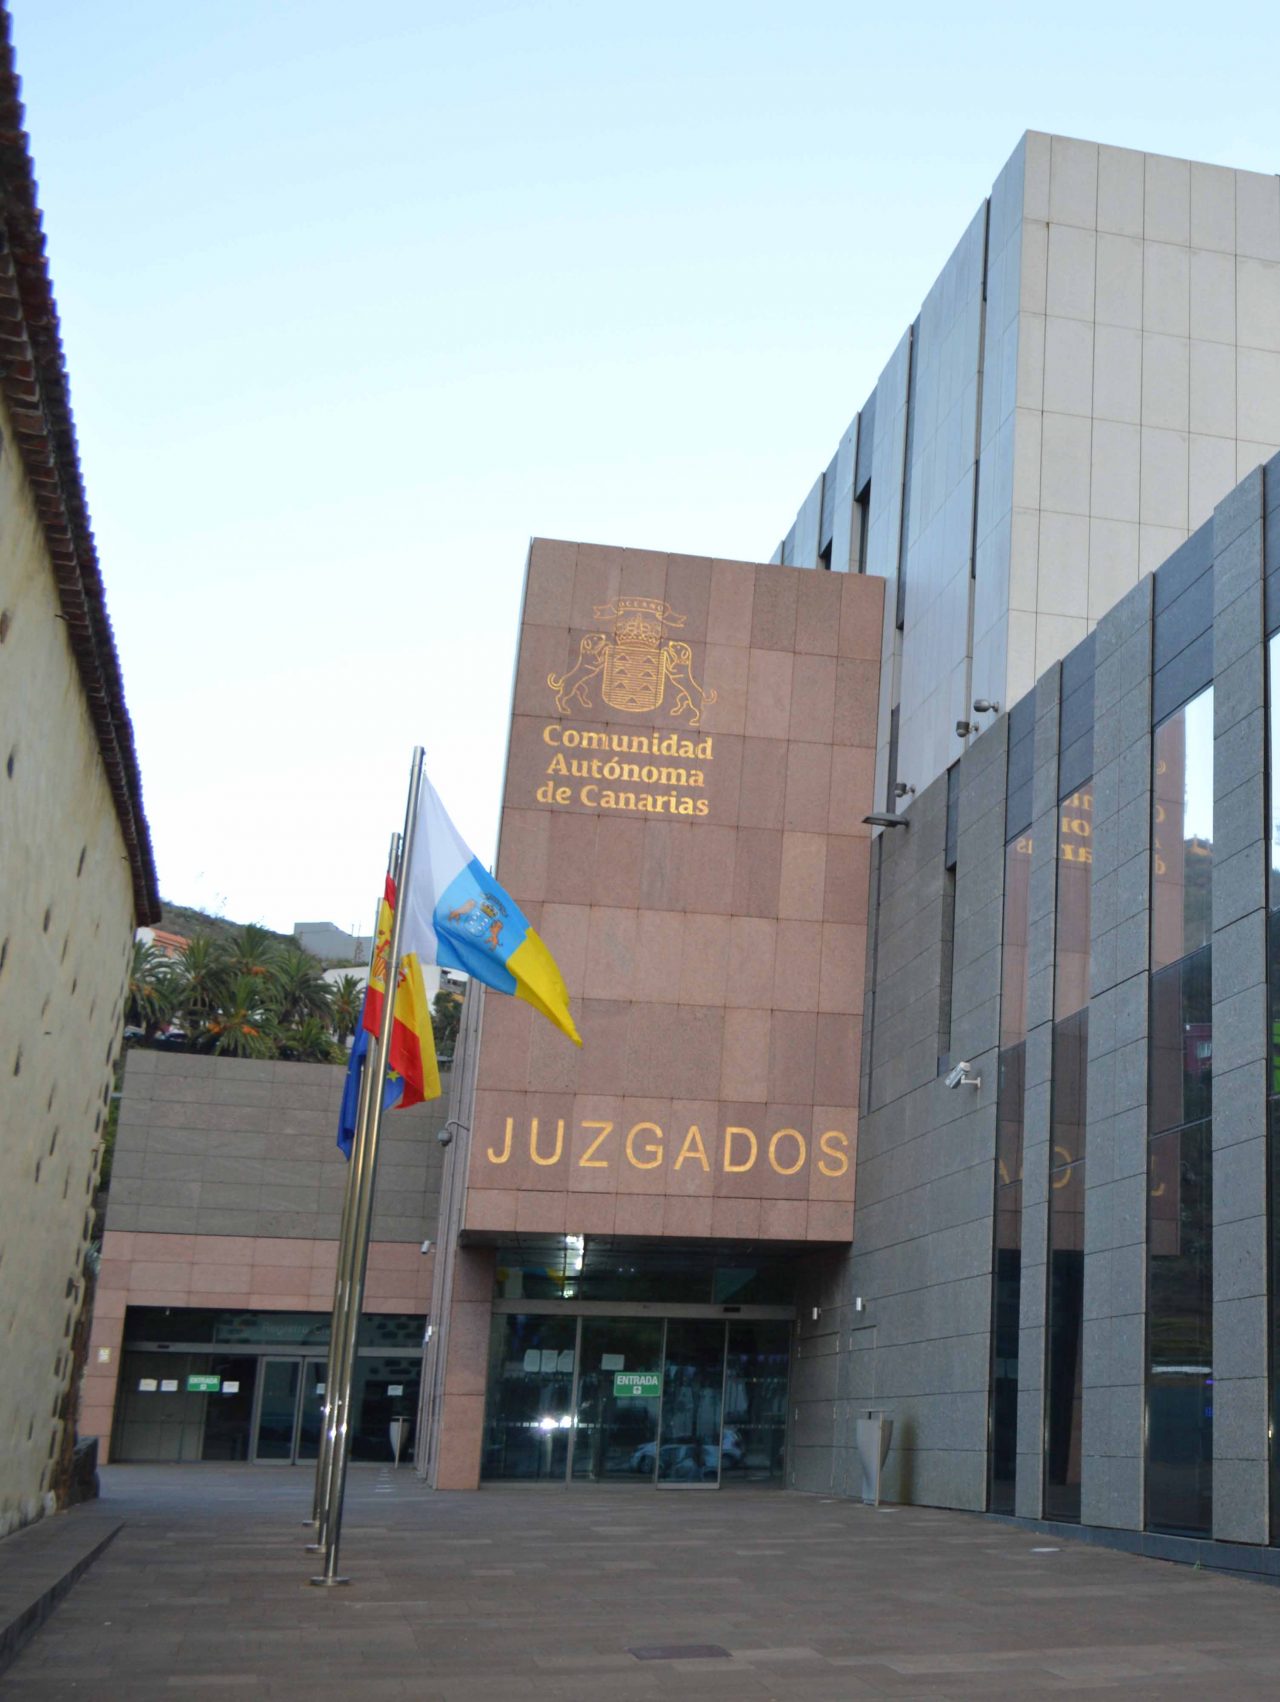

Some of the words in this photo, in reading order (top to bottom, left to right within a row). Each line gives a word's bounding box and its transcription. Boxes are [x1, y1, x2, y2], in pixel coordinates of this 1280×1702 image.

[542, 724, 713, 760] Comunidad
[546, 752, 706, 787] Autónoma
[536, 781, 572, 804] de
[580, 784, 710, 816] Canarias
[486, 1117, 849, 1177] JUZGADOS
[616, 1375, 659, 1386] ENTRADA
